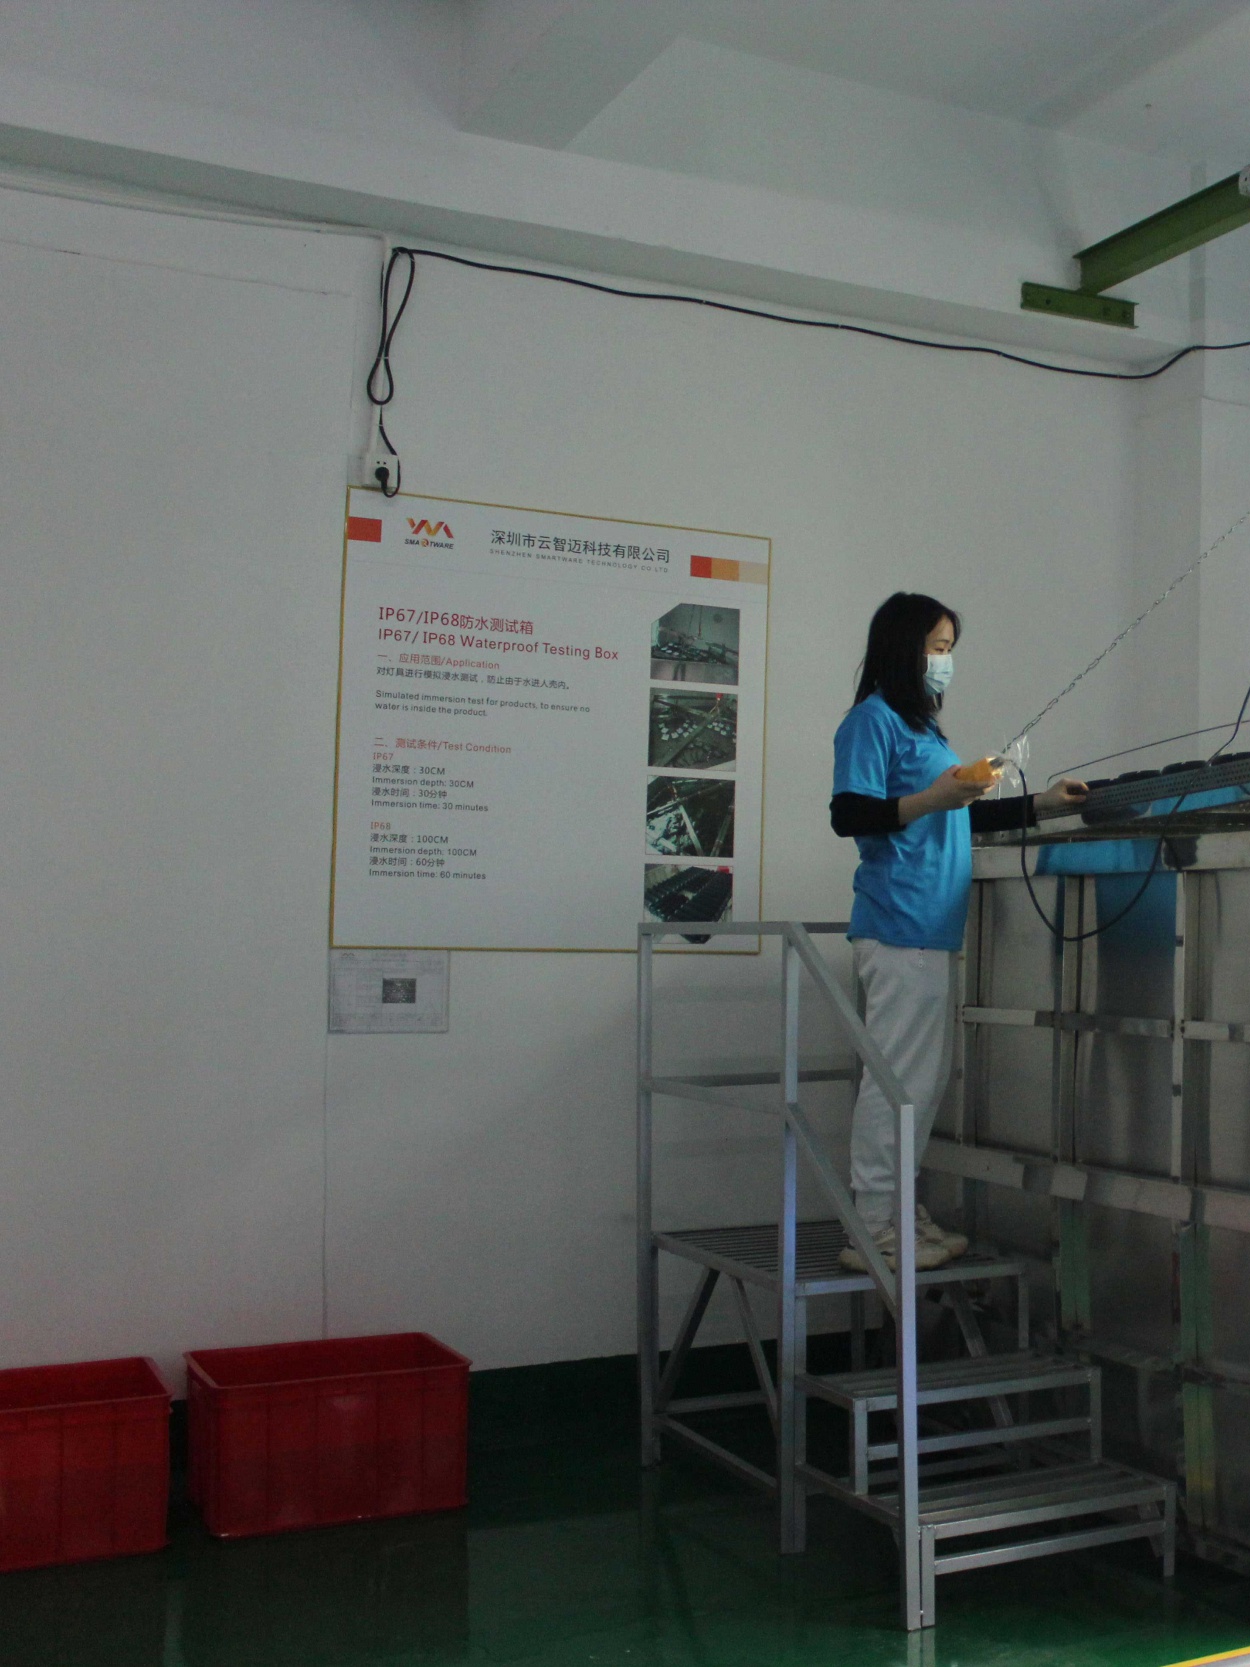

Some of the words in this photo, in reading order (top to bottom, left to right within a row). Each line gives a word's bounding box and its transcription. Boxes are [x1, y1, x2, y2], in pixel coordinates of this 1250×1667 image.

[491, 529, 670, 564] 深圳市云智迈科技有限公司
[490, 548, 532, 558] SHENZHEN
[536, 554, 582, 564] SMARTWARE
[587, 559, 637, 569] TECHNOLOGY
[379, 606, 534, 635] IP67/IP68防水测试箱
[379, 628, 419, 644] IP67/
[423, 632, 455, 646] IP68
[460, 634, 538, 653] Waterproof
[542, 642, 590, 660] Testing
[595, 647, 618, 660] Box
[376, 690, 420, 700] Simulated
[422, 694, 466, 703] immersion
[486, 697, 498, 706] for
[550, 704, 578, 712] ensure
[375, 702, 400, 710] water
[411, 704, 436, 713] inside
[438, 706, 452, 714] the
[466, 743, 512, 754] Condition
[373, 752, 394, 760] IP67
[372, 776, 418, 786] Immersion
[420, 778, 446, 788] depth:
[450, 780, 474, 788] 30CM
[372, 800, 417, 808] Immersion
[419, 802, 440, 810] time:
[442, 802, 452, 810] 30
[455, 804, 488, 812] minutes
[370, 822, 391, 830] IP68
[370, 846, 415, 854] Immersion
[418, 848, 444, 857] depth:
[448, 848, 477, 856] 100CM
[370, 869, 414, 878] Immersion
[417, 870, 437, 878] time:
[453, 872, 486, 880] minutes
